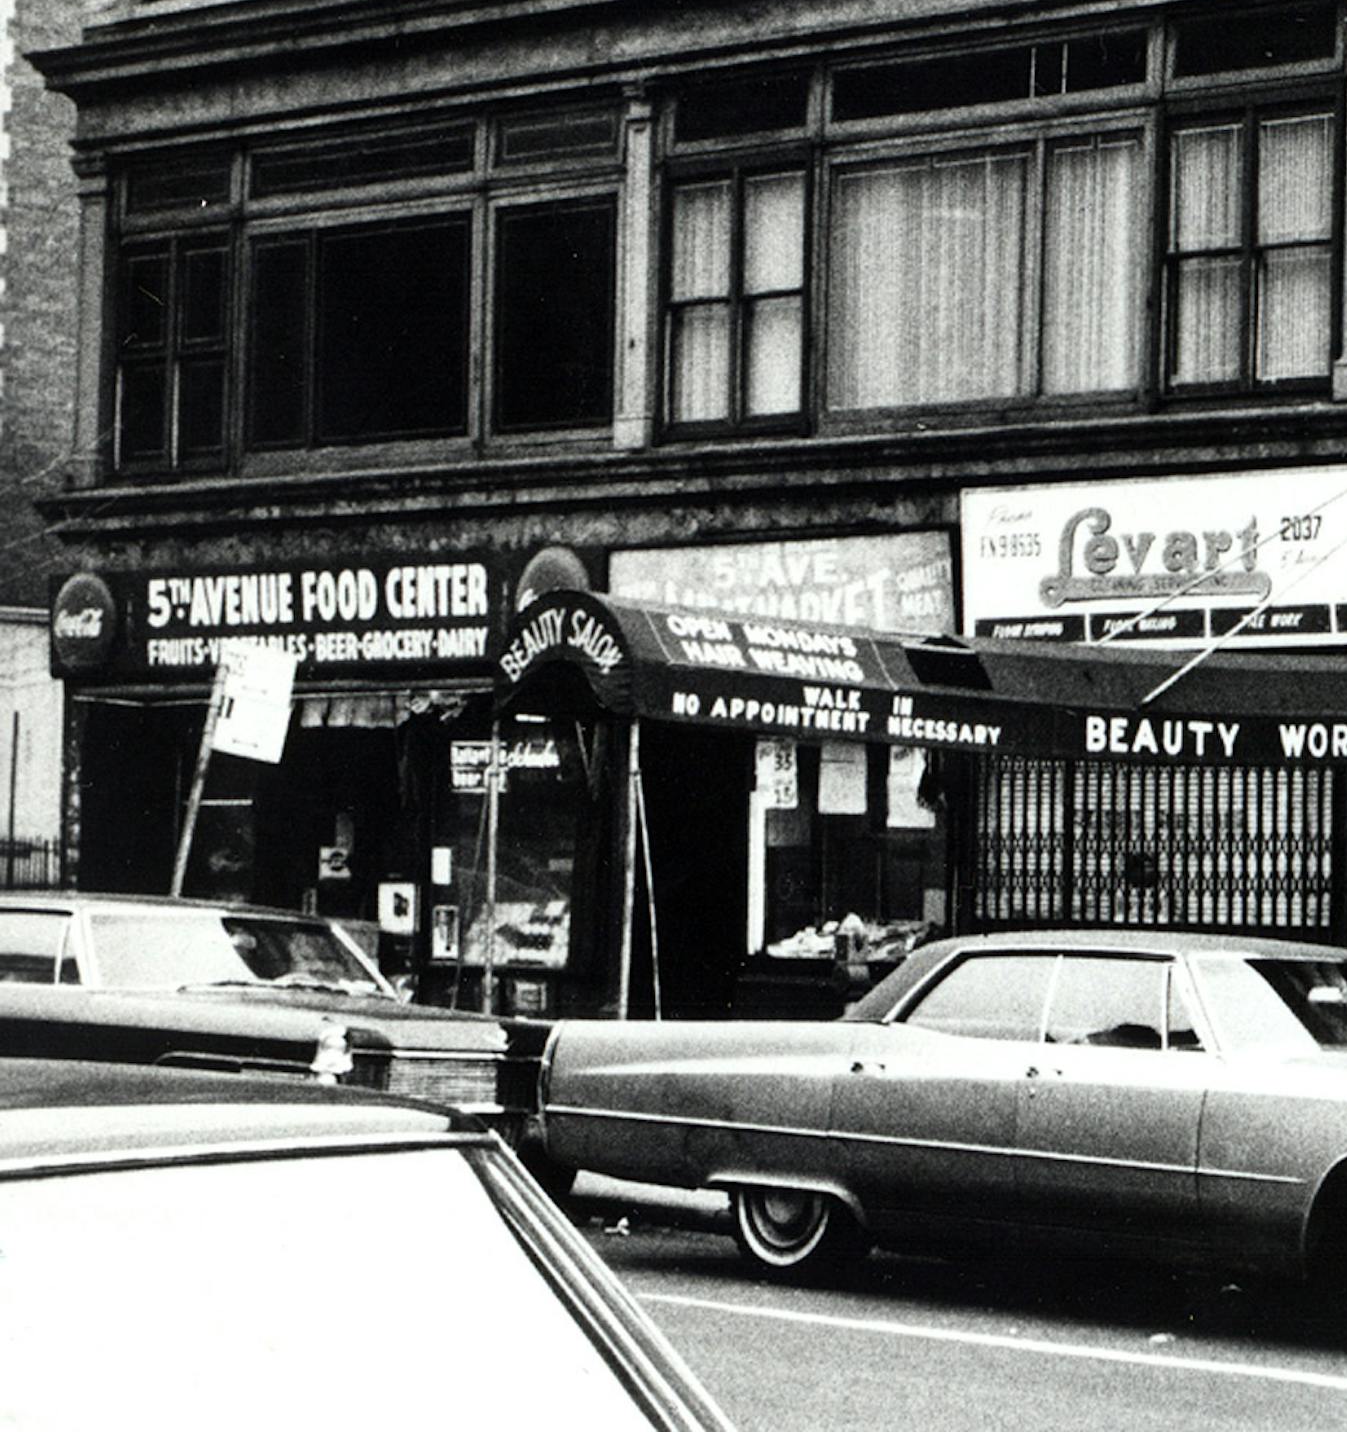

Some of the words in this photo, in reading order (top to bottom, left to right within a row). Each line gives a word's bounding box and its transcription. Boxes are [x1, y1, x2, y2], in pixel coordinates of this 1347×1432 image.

[1280, 514, 1323, 542] 2037
[189, 572, 294, 627] AVENUE
[300, 568, 378, 622] FOOD
[385, 562, 489, 618] CENTER
[147, 637, 205, 666] FRUITS
[313, 631, 359, 663] BEER
[359, 628, 434, 660] GROCERY
[437, 625, 489, 658] DAIRY
[500, 608, 567, 683] BEAUTY
[567, 609, 624, 675] SALON
[666, 614, 733, 641] OPEN
[742, 622, 858, 658] MONDAYS
[748, 647, 865, 683] WEAVING
[672, 691, 700, 716] NO
[710, 697, 871, 733] APPOINTMENT
[887, 716, 1002, 746] NECESSARY
[802, 685, 862, 711] WALK
[893, 695, 914, 716] IN
[1085, 717, 1242, 758] BEAUTY
